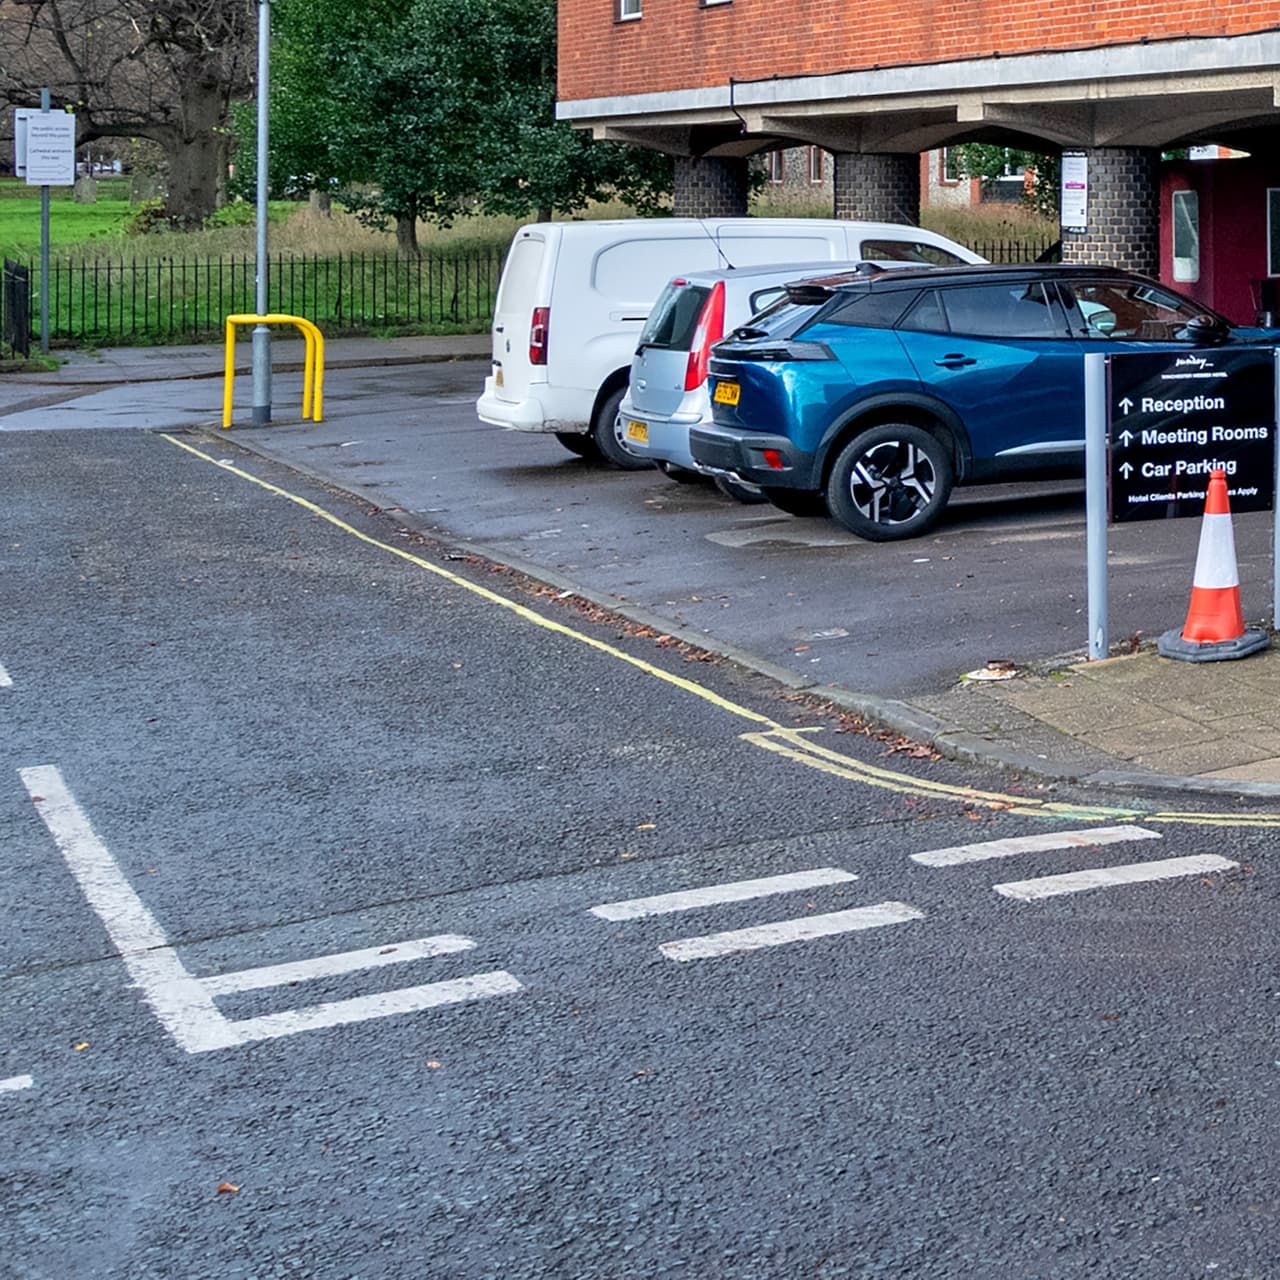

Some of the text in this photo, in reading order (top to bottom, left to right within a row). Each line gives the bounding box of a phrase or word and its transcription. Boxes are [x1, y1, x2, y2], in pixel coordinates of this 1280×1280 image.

[1141, 395, 1225, 414] Reception
[1141, 426, 1268, 445] Meeting Rooms
[1141, 458, 1237, 478] Car Parking
[1128, 494, 1149, 503] Hotel
[1150, 492, 1176, 502] Clients
[1177, 491, 1205, 500] Parking
[1237, 487, 1258, 496] Apply
